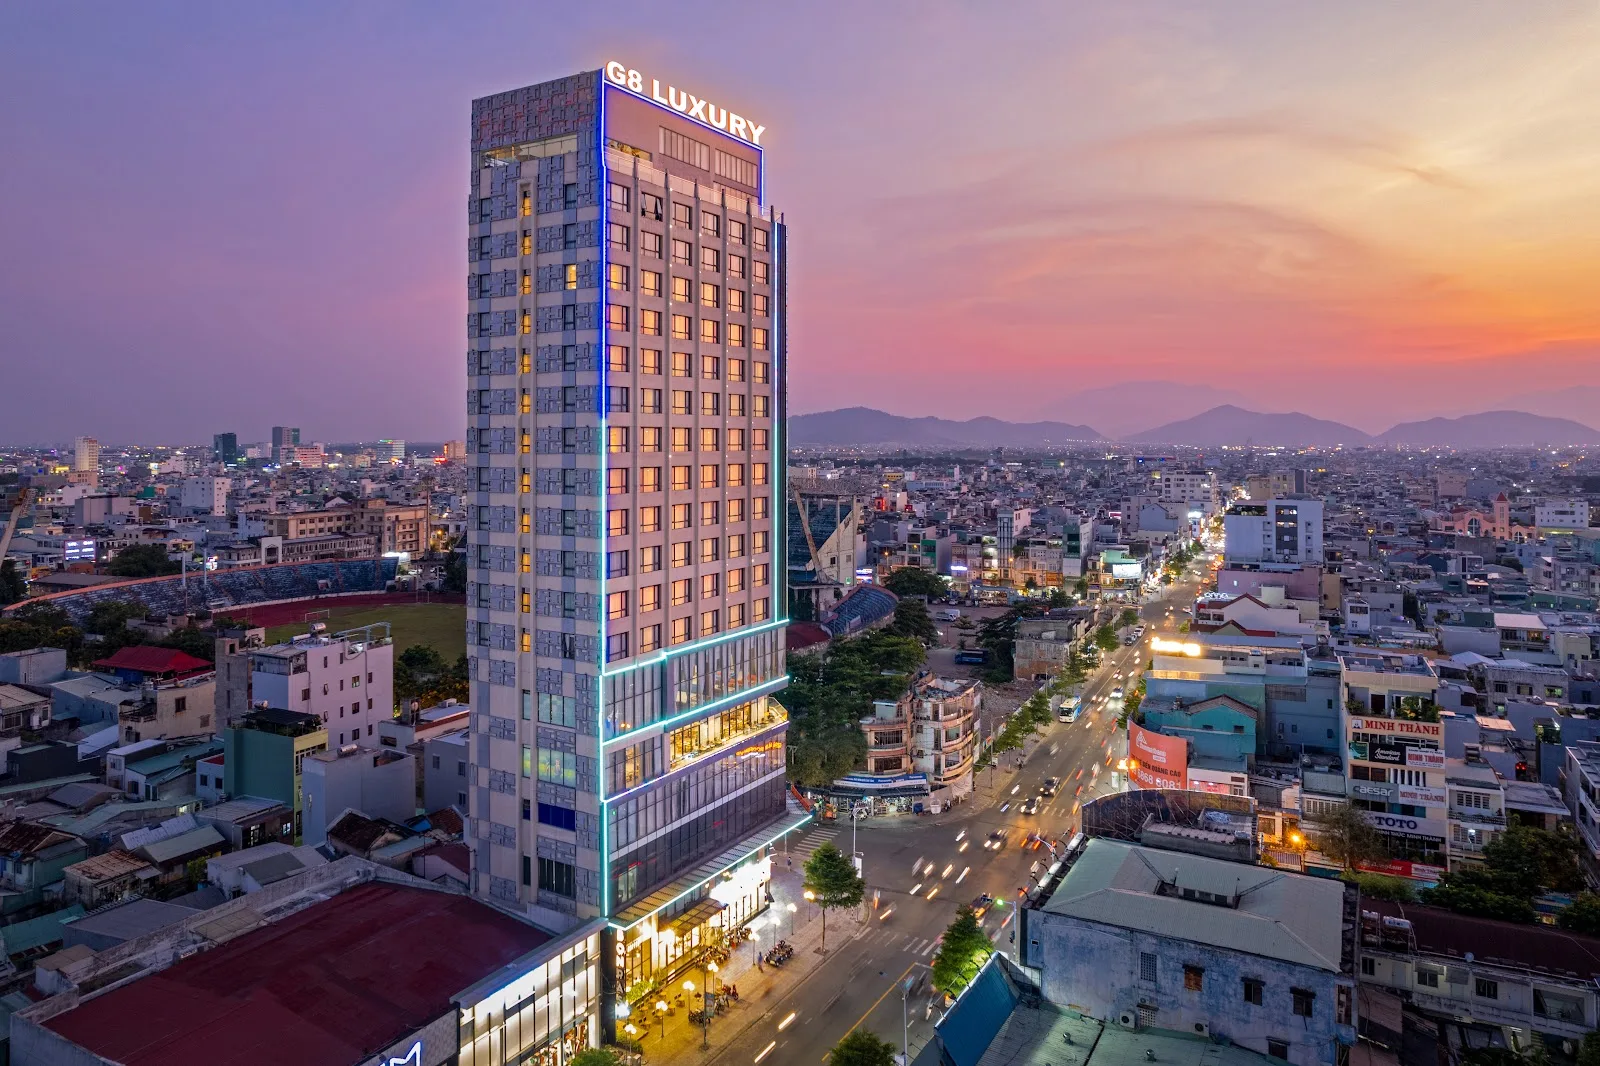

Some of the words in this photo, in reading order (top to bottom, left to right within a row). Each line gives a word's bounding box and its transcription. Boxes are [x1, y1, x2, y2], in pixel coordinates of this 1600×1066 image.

[606, 61, 643, 93] G8
[652, 79, 766, 145] LUXURY
[1365, 720, 1395, 731] MINH
[1399, 722, 1440, 735] THÀNH
[1374, 752, 1400, 761] Standard
[1375, 816, 1417, 830] TOTO
